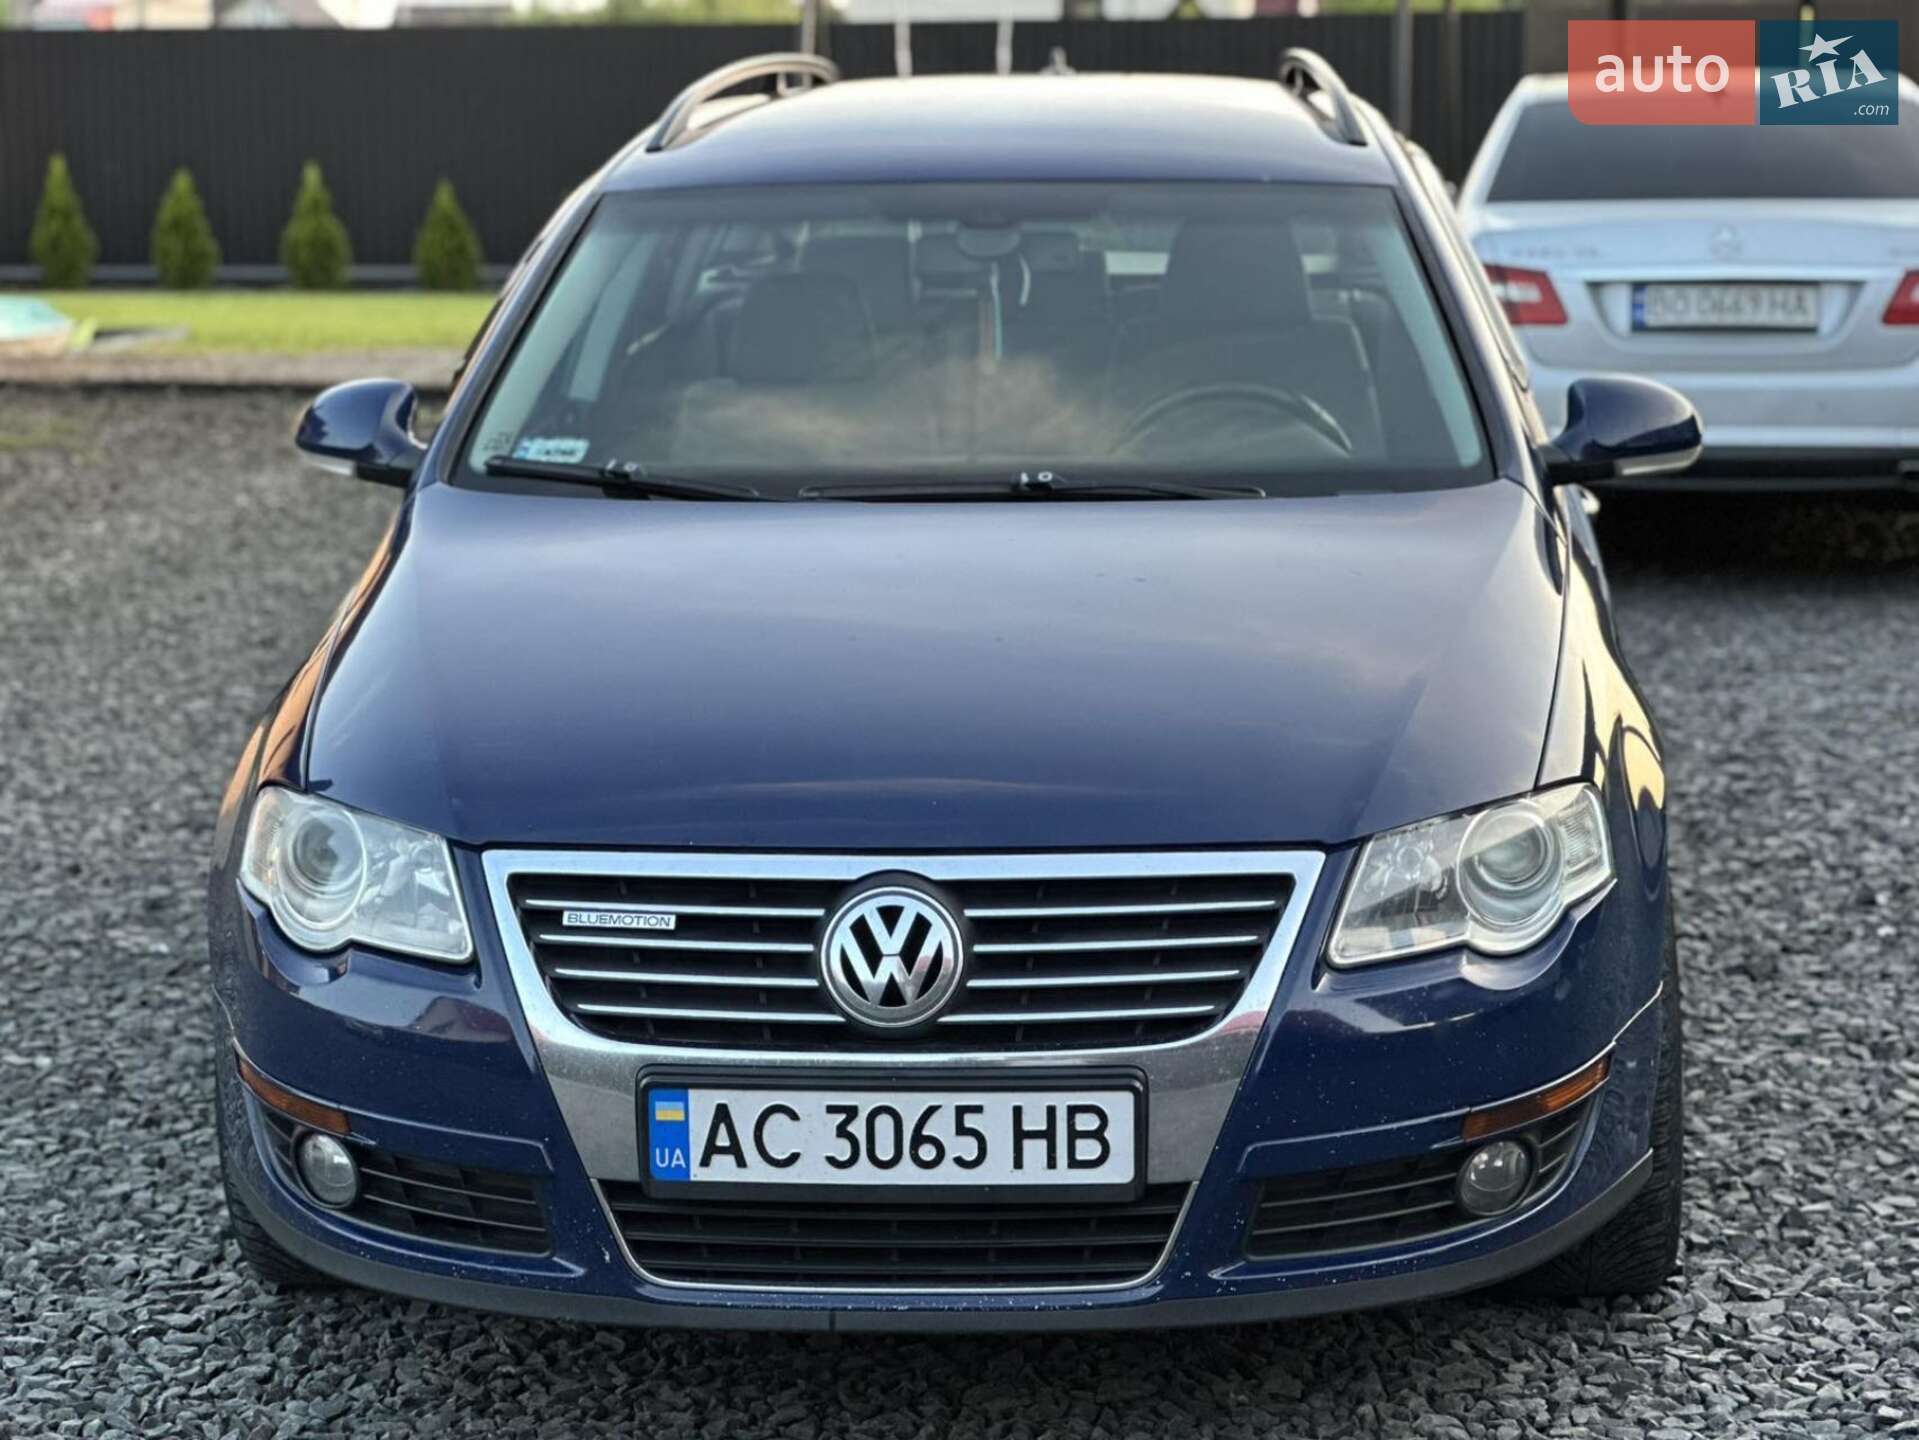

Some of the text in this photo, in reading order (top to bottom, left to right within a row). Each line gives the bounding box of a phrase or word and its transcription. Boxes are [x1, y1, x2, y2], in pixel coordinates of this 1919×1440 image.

[567, 912, 671, 927] BLUEMOTION
[699, 1103, 1110, 1170] AC 3065 HB
[655, 1148, 686, 1168] UA
